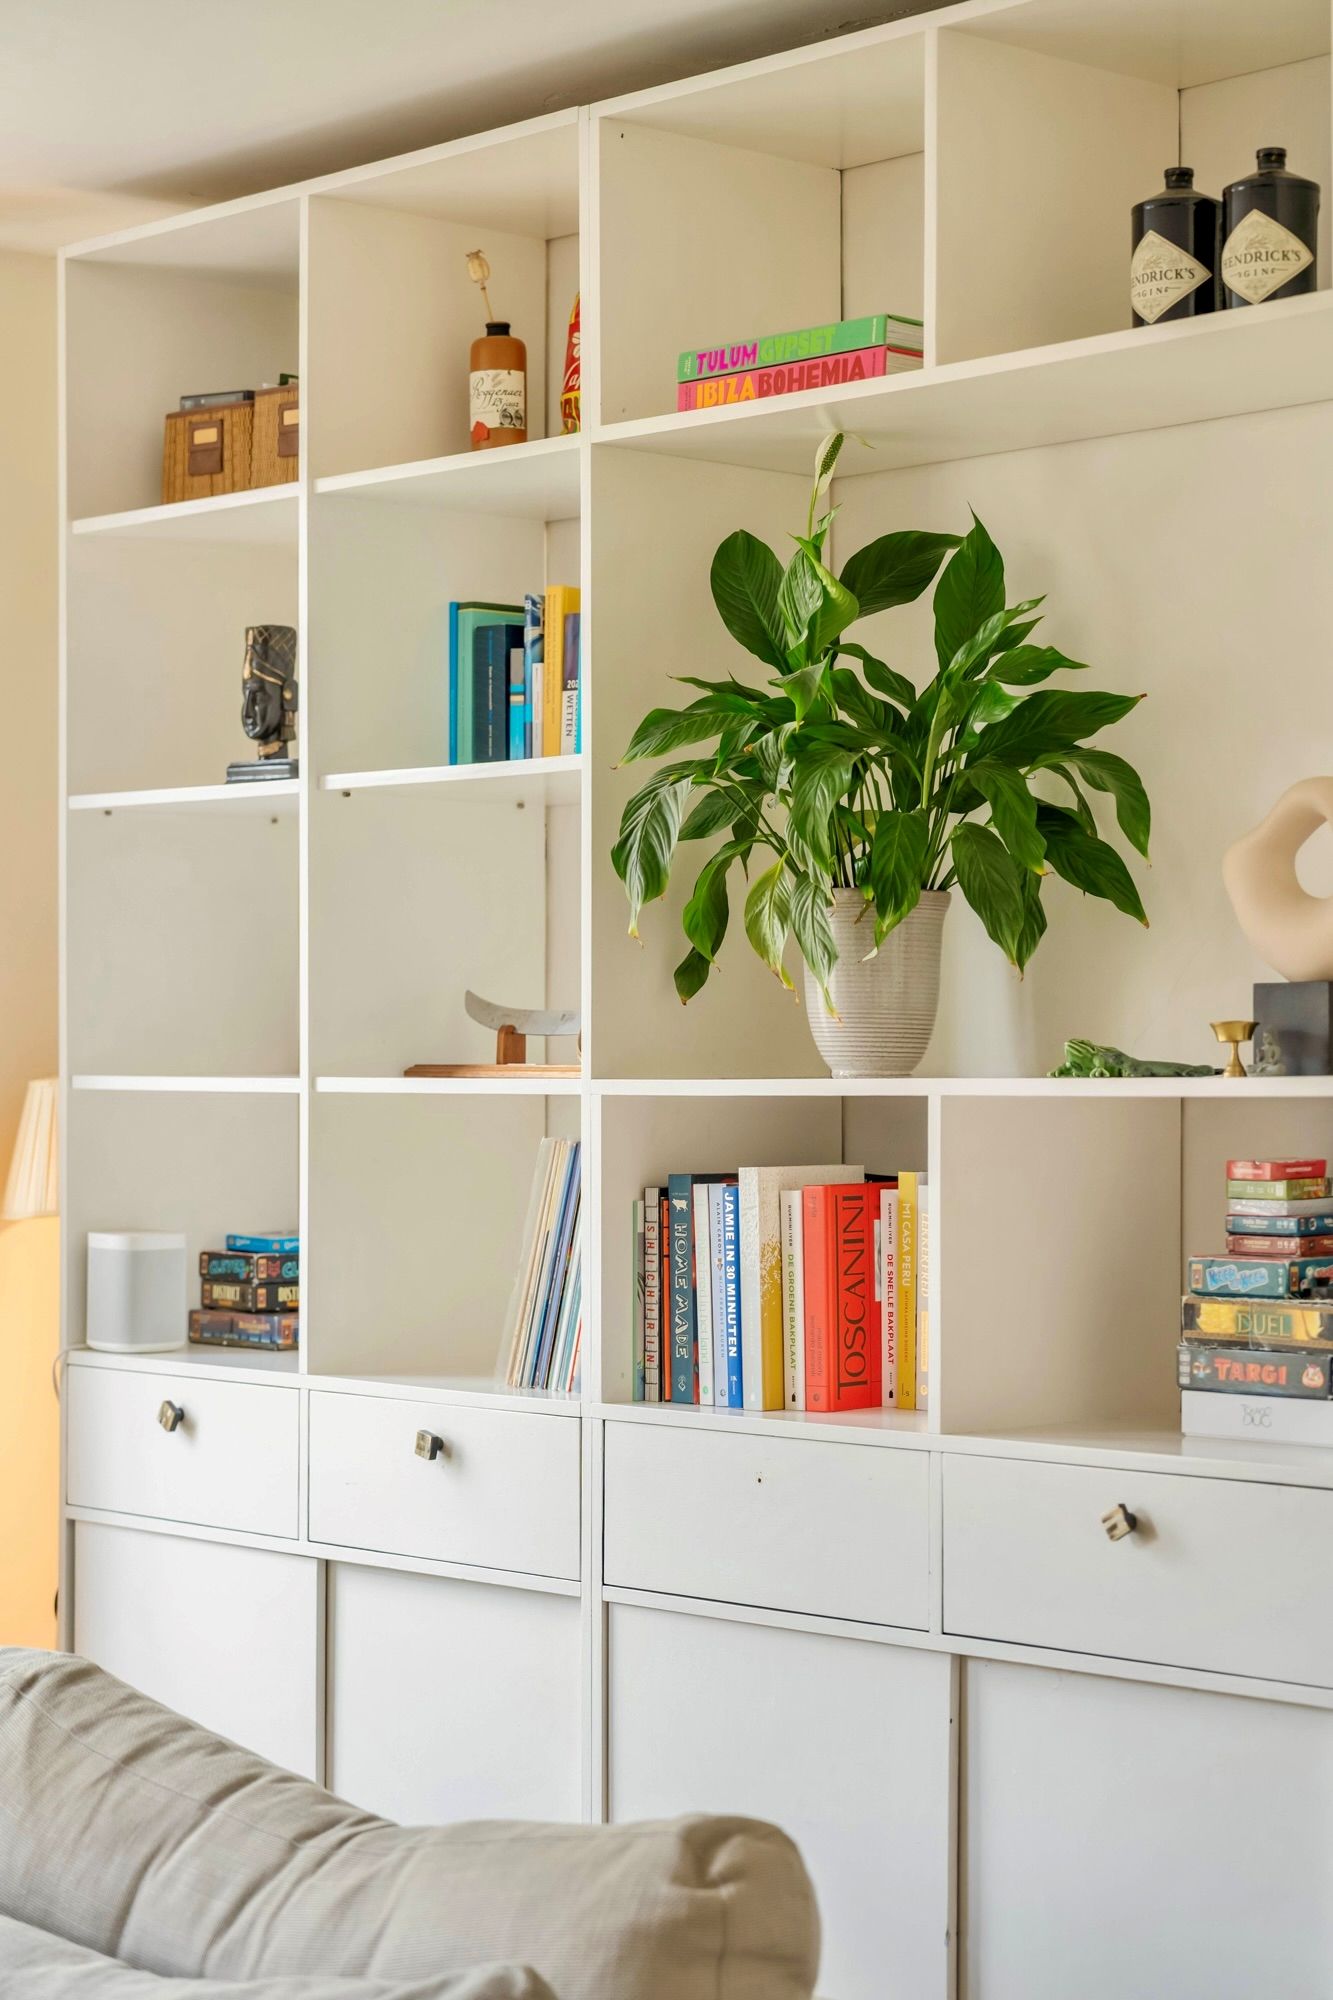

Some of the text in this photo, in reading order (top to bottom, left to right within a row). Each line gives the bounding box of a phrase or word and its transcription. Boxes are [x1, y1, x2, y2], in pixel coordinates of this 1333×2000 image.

[1131, 267, 1196, 288] ENDRICK'S
[1243, 267, 1269, 278] GIN
[696, 340, 758, 376] TULUM
[760, 326, 836, 363] GYPSET
[695, 375, 756, 409] IBIZA
[758, 354, 866, 398] BOHEMIA
[565, 694, 575, 737] WETTEN
[902, 1203, 911, 1218] MI
[902, 1221, 911, 1253] CASA
[724, 1191, 738, 1358] JAMIE IN 30 MINUTEN
[787, 1253, 796, 1268] DE
[887, 1253, 895, 1268] DE
[902, 1255, 911, 1286] PERU
[645, 1224, 656, 1364] SHICHIRIN
[673, 1222, 689, 1359] HOME MADE
[788, 1270, 796, 1314] GROENE
[838, 1194, 868, 1390] TOSCANINI
[887, 1270, 895, 1308] SNELLE
[788, 1316, 797, 1371] BAKPLAAT
[887, 1310, 895, 1365] BAKPLAAT
[1236, 1309, 1291, 1338] DUEL
[1214, 1357, 1287, 1386] TARGI
